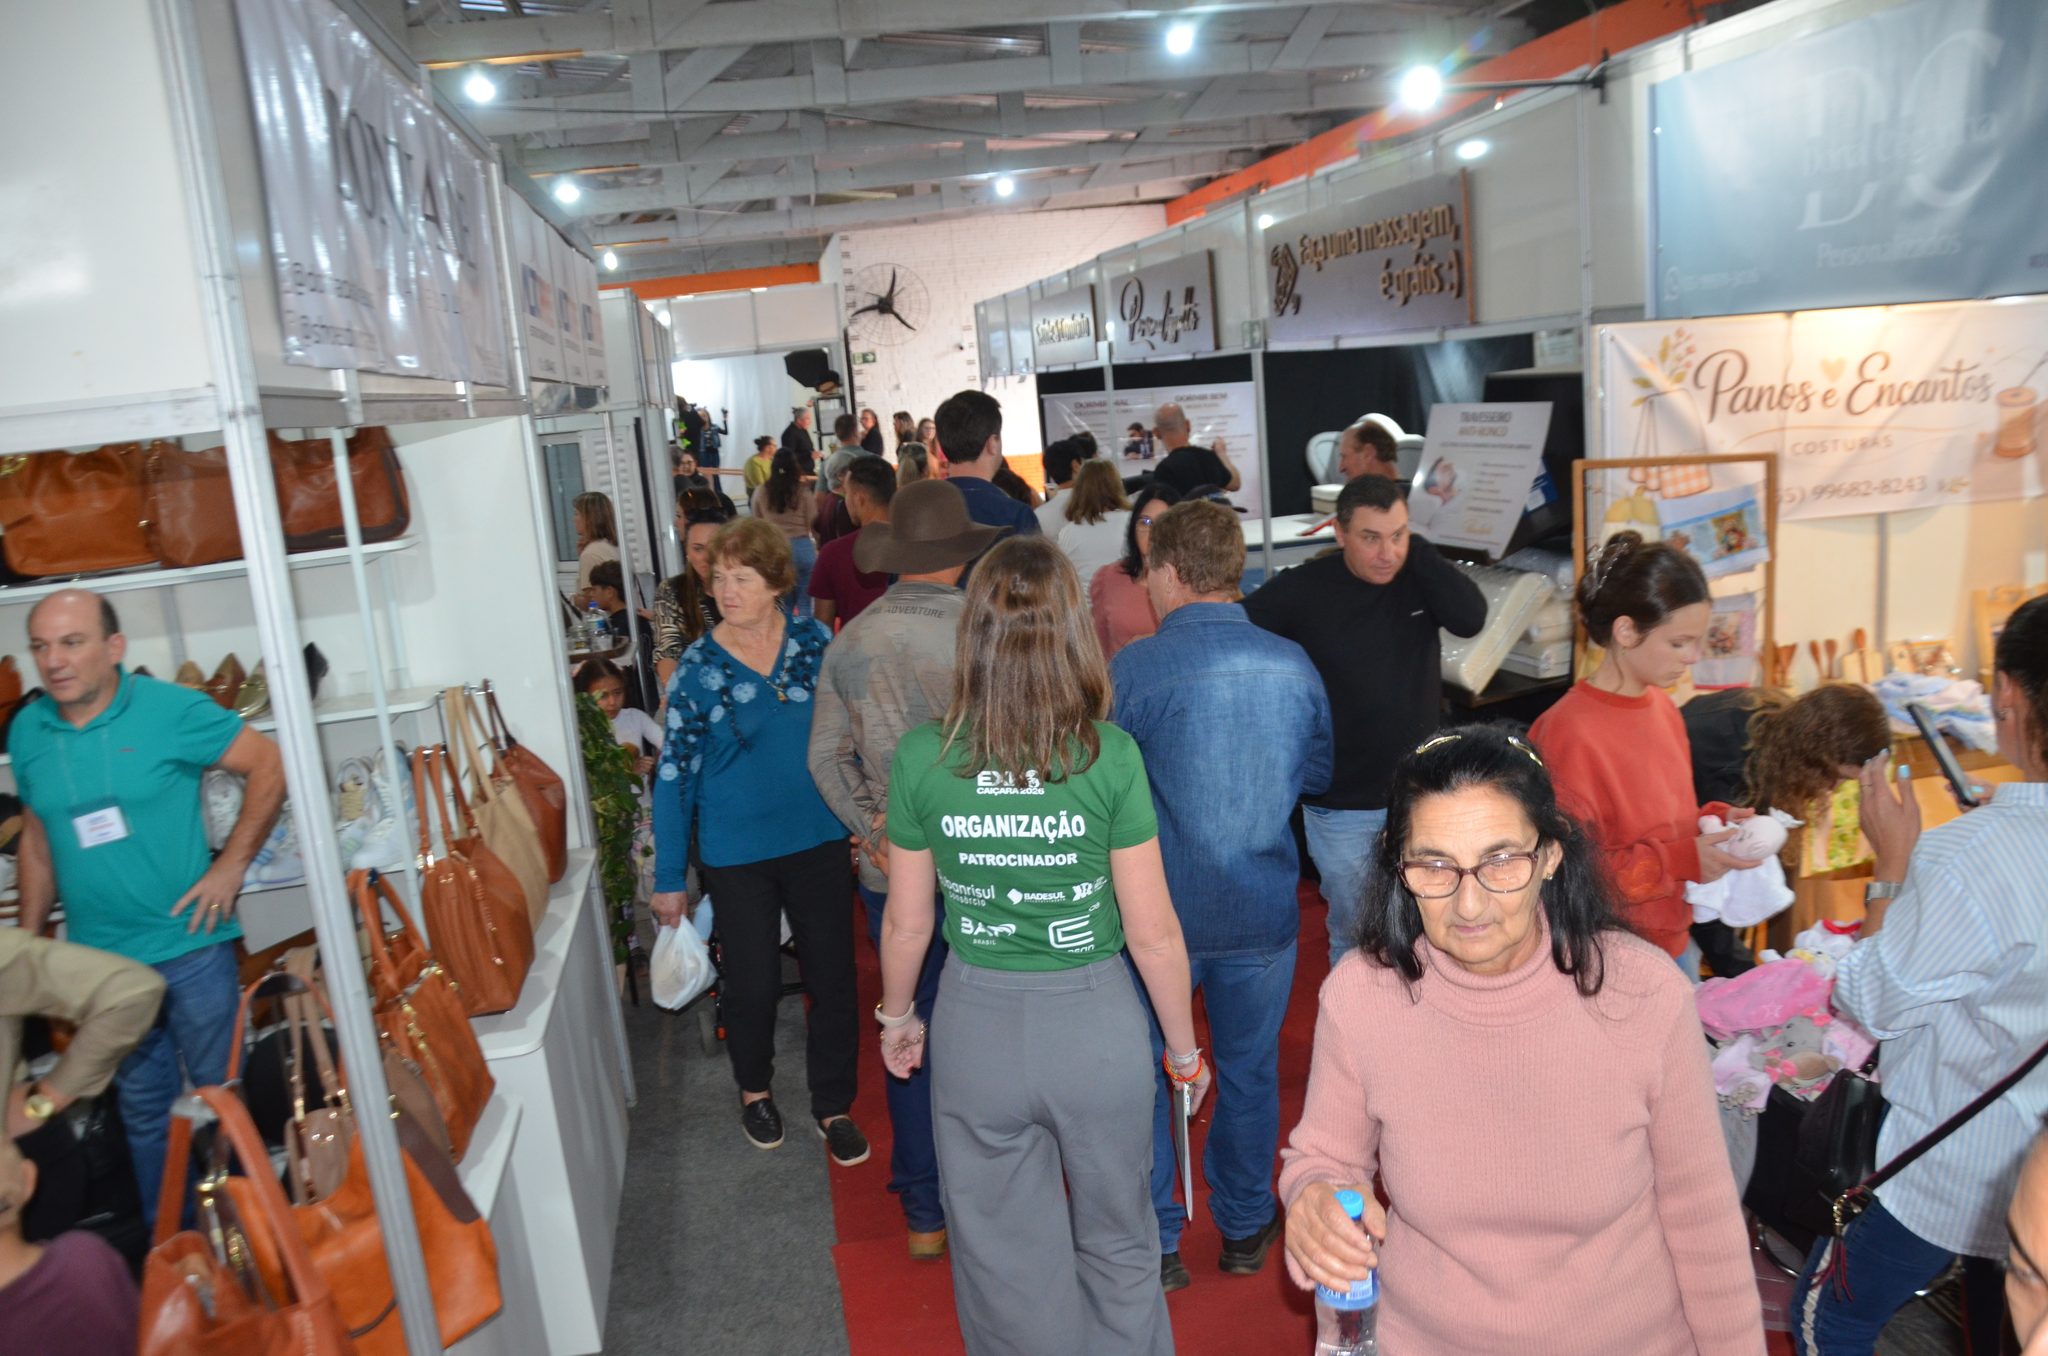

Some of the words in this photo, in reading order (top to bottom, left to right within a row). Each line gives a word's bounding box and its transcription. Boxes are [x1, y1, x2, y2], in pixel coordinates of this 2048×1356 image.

[1299, 233, 1327, 272] Faça
[1327, 227, 1363, 259] uma
[1363, 203, 1460, 249] massagem,
[1379, 258, 1394, 299] é
[1395, 253, 1444, 306] grátis
[1692, 349, 1816, 424] Panos
[1821, 387, 1839, 408] e
[1845, 351, 1997, 416] Encantos
[1791, 433, 1893, 455] COSTURAS
[1812, 475, 1927, 500] 99682-8243
[976, 786, 1020, 796] CAIÇARA
[941, 809, 1086, 844] ORGANIZAÇÃO
[958, 852, 1078, 867] PATROCINADOR
[1023, 891, 1066, 900] BADESUL
[973, 938, 997, 946] BRASIL
